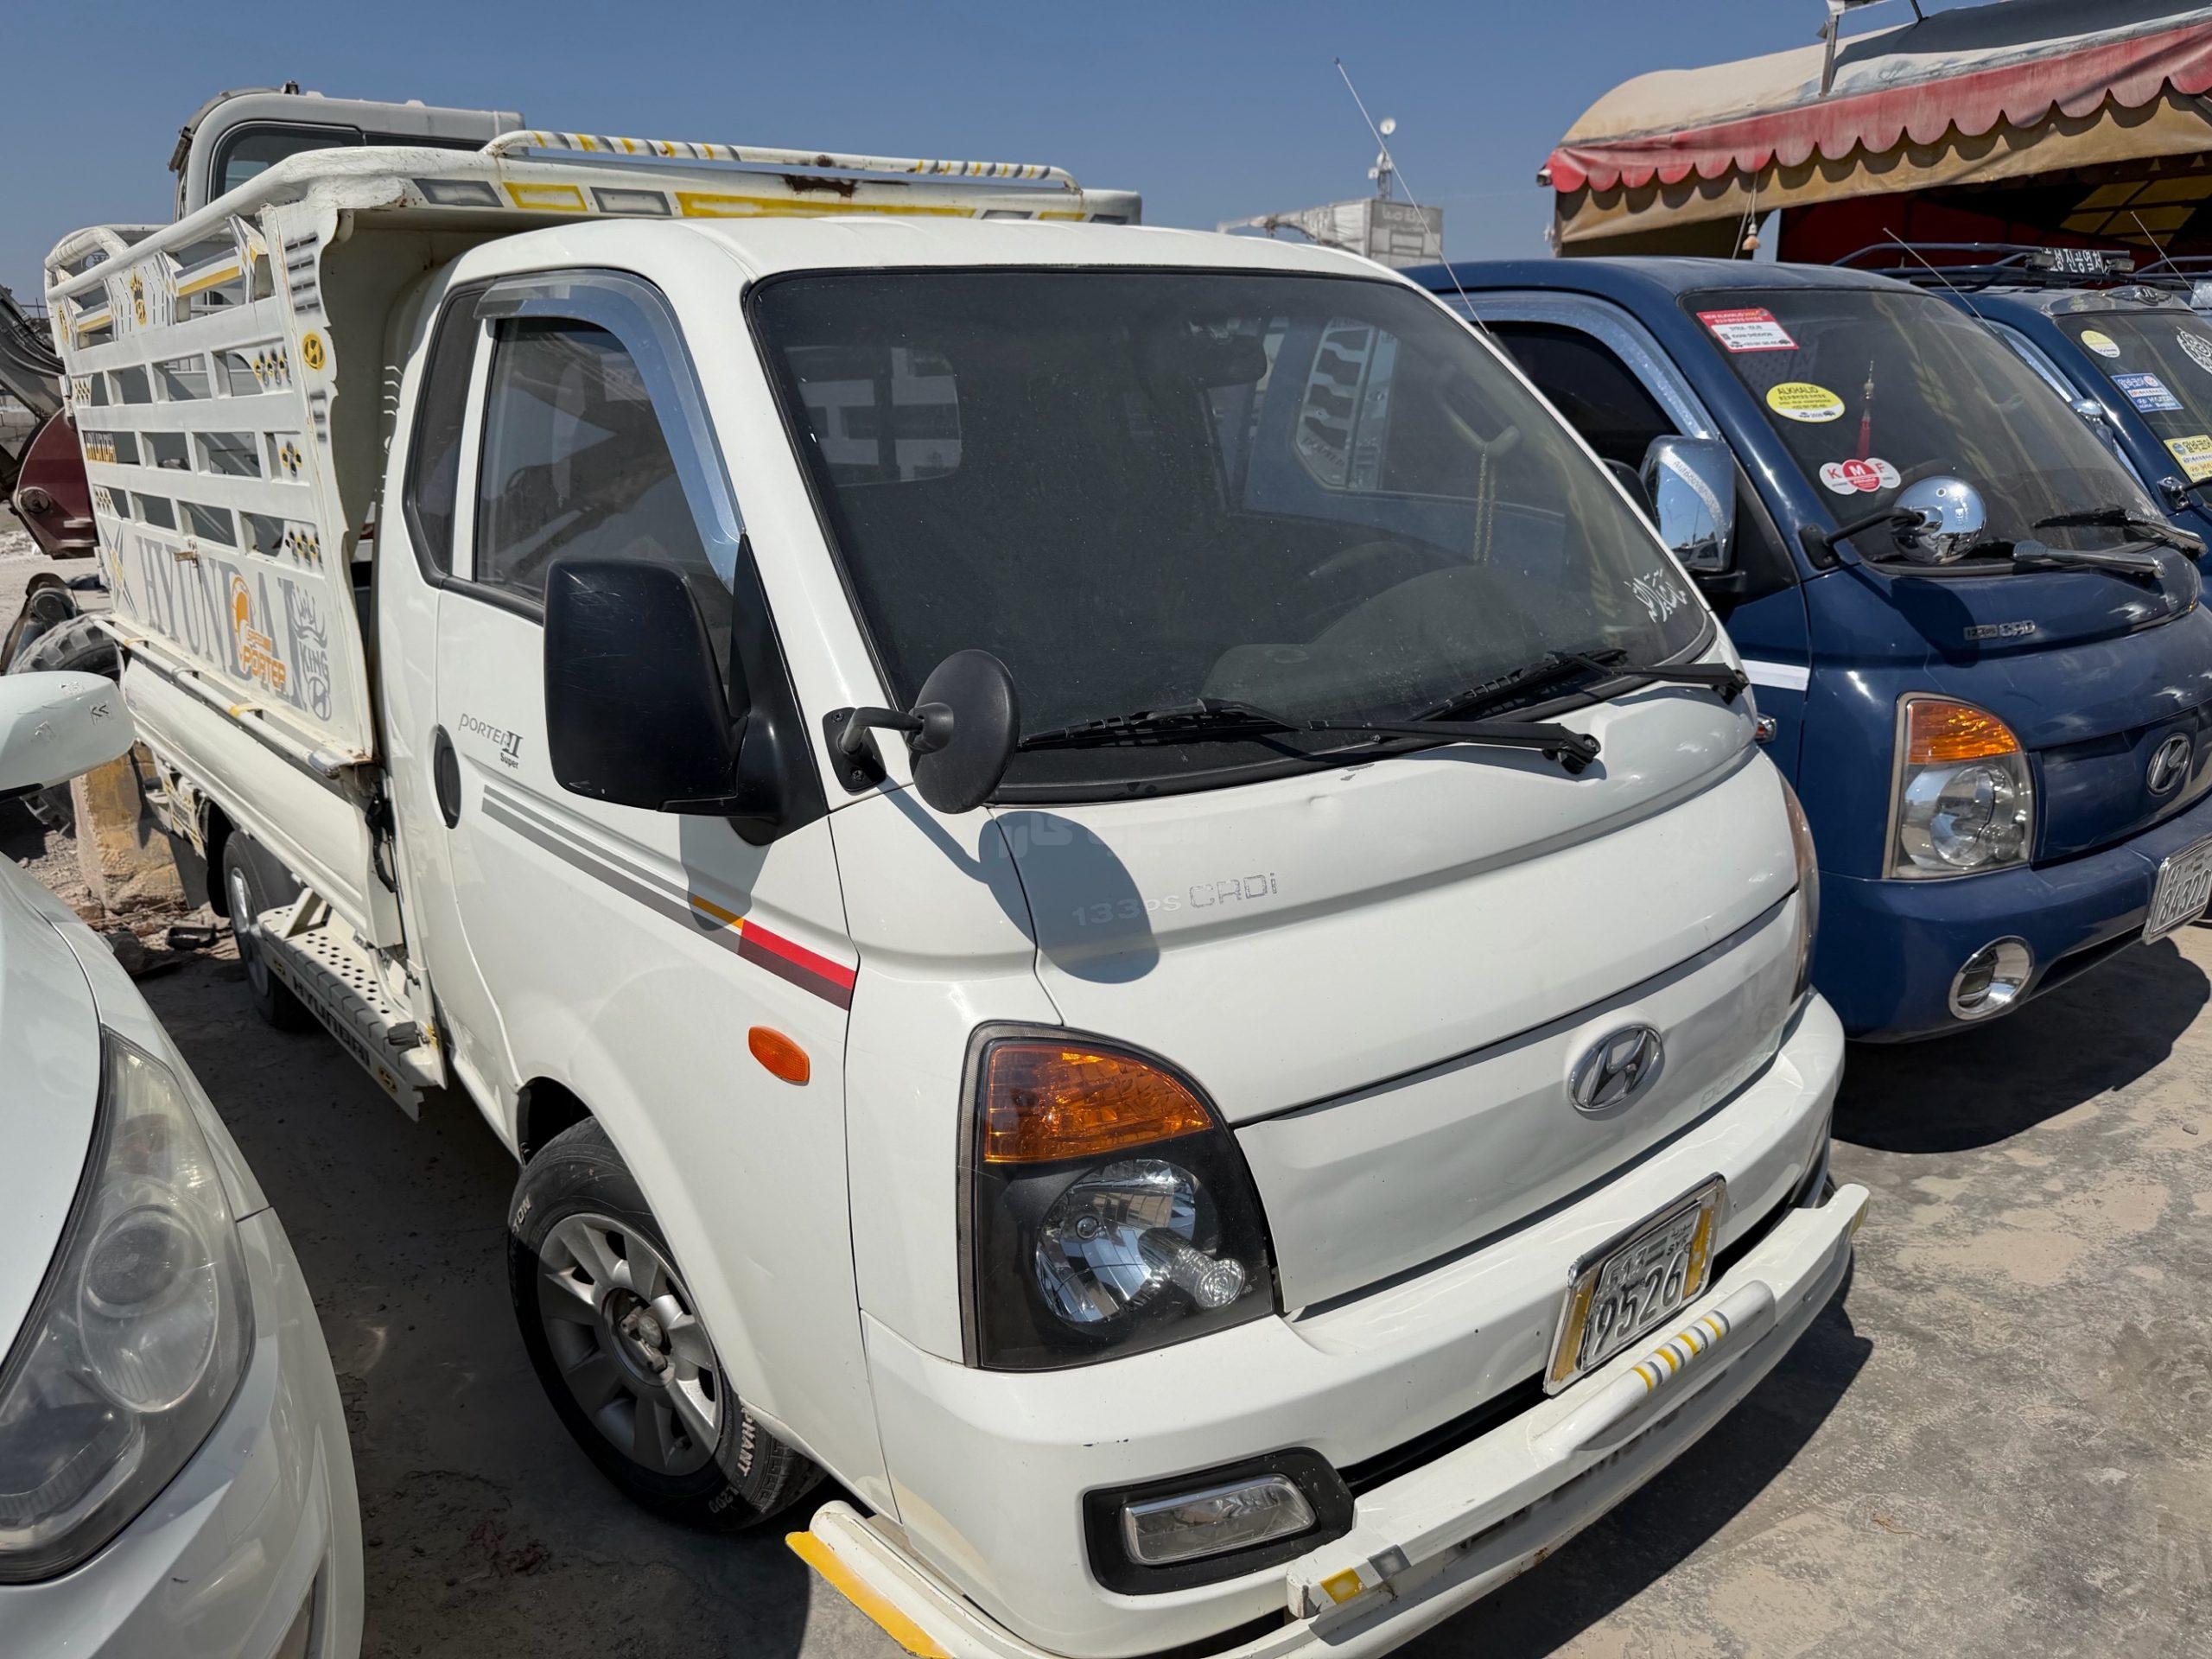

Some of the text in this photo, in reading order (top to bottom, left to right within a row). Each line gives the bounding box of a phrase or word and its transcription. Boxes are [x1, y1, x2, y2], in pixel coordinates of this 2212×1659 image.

[1777, 386, 1819, 395] ALKHALID
[1848, 464, 1866, 477] M
[137, 536, 308, 712] HYUNDAI
[242, 644, 288, 695] PORTER
[300, 644, 329, 683] KING
[458, 713, 511, 748] PORTER
[500, 753, 519, 769] Super
[1189, 873, 1278, 909] CRDi
[292, 976, 372, 1068] HYUNDAI
[1592, 1249, 1684, 1357] 9526
